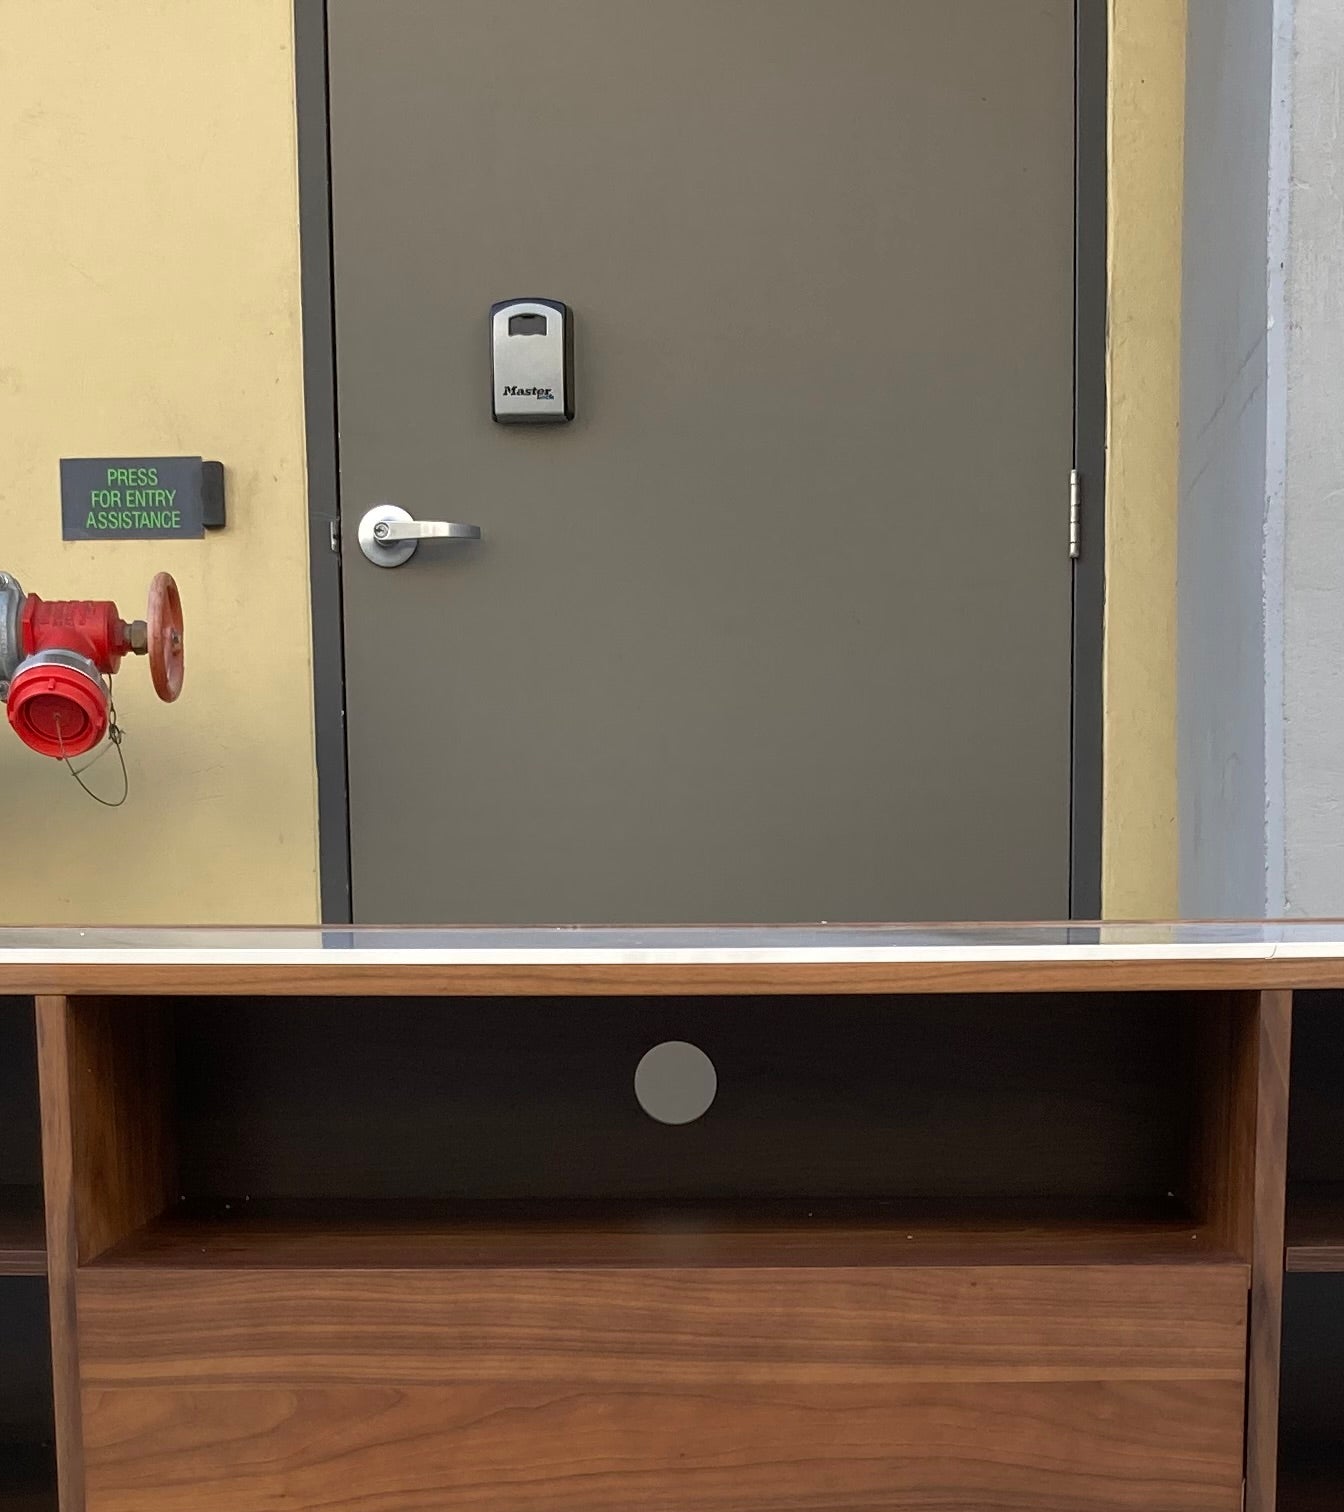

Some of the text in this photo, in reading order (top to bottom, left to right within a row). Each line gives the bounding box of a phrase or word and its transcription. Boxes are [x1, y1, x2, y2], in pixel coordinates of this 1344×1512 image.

[503, 386, 552, 396] Master
[107, 468, 158, 486] PRESS
[91, 489, 176, 508] FOR ENTRY
[86, 511, 182, 529] ASSISTANCE
